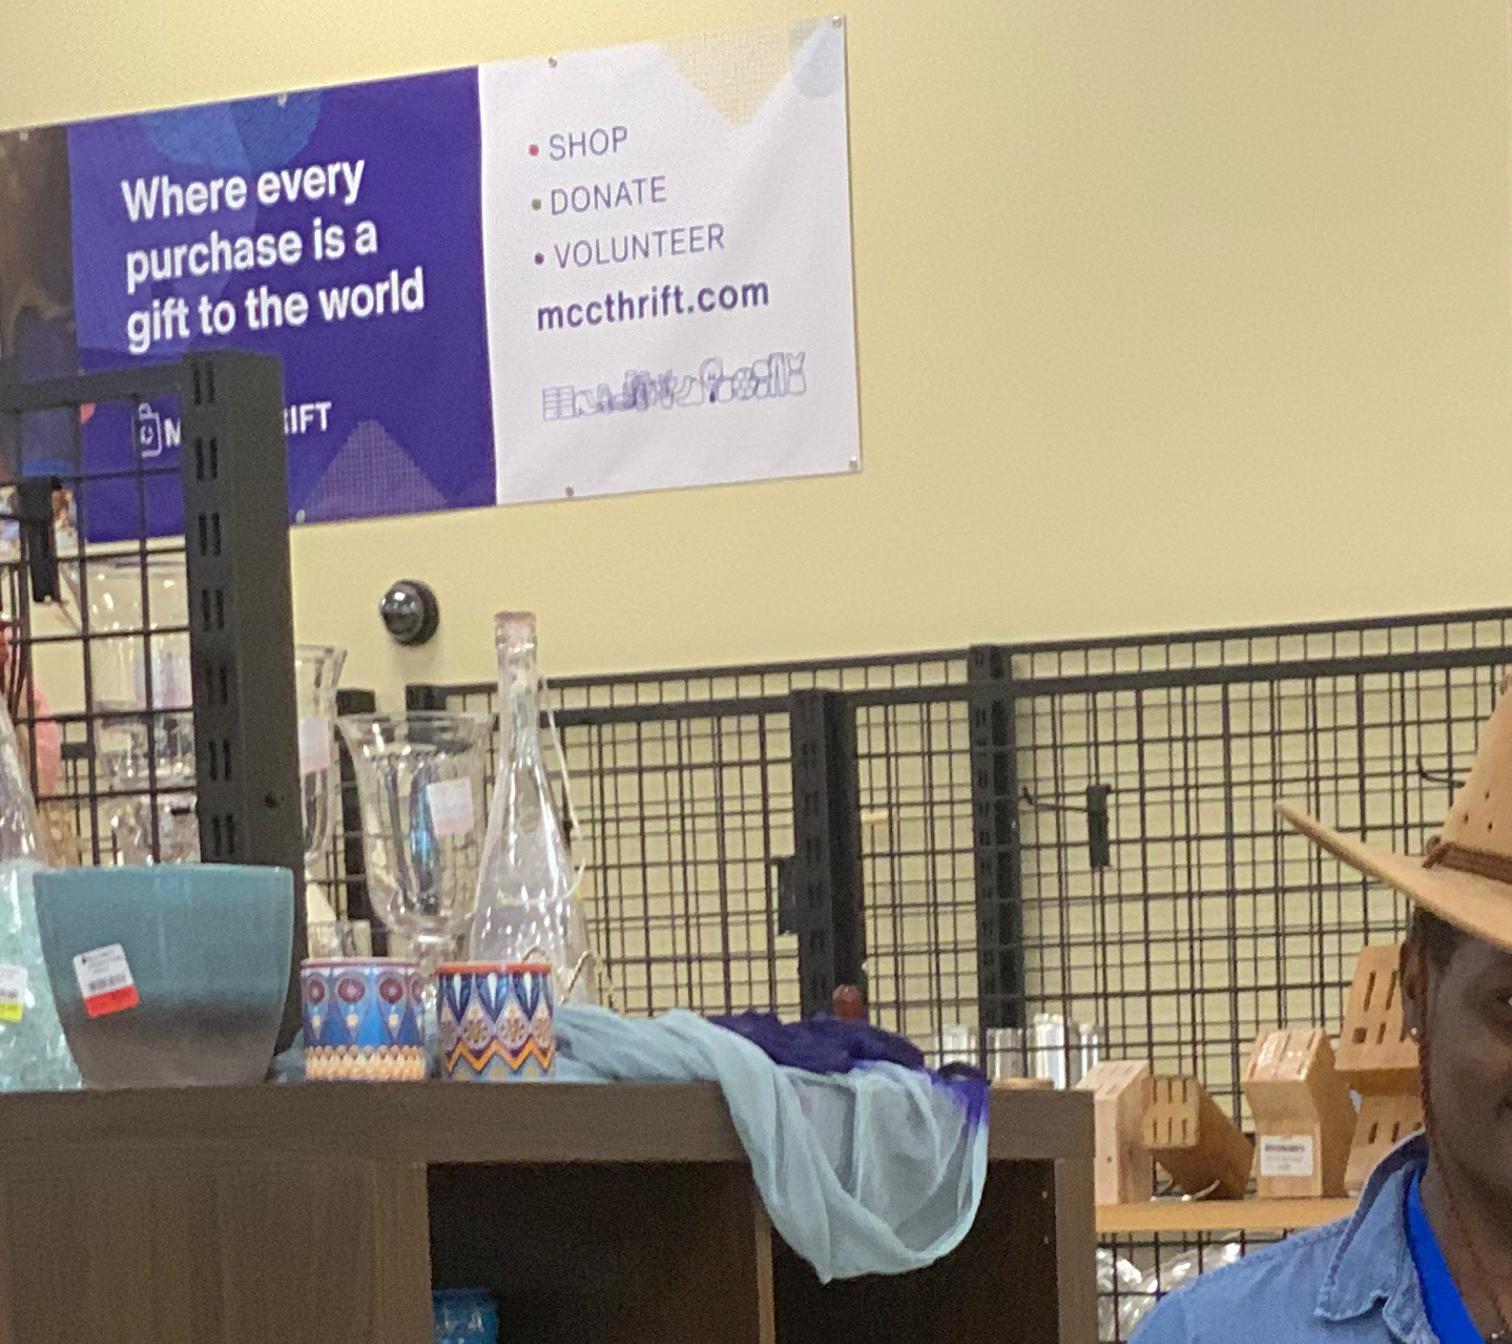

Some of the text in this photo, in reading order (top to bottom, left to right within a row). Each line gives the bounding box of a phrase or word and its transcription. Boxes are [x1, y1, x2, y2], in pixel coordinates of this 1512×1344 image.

[550, 126, 628, 161] SHOP
[121, 160, 365, 222] Where every
[551, 175, 667, 215] DONATE
[126, 217, 378, 295] purchase is a
[554, 223, 725, 269] VOLUNTEER
[127, 266, 425, 354] gift to the world
[537, 281, 769, 331] mccthrift.com
